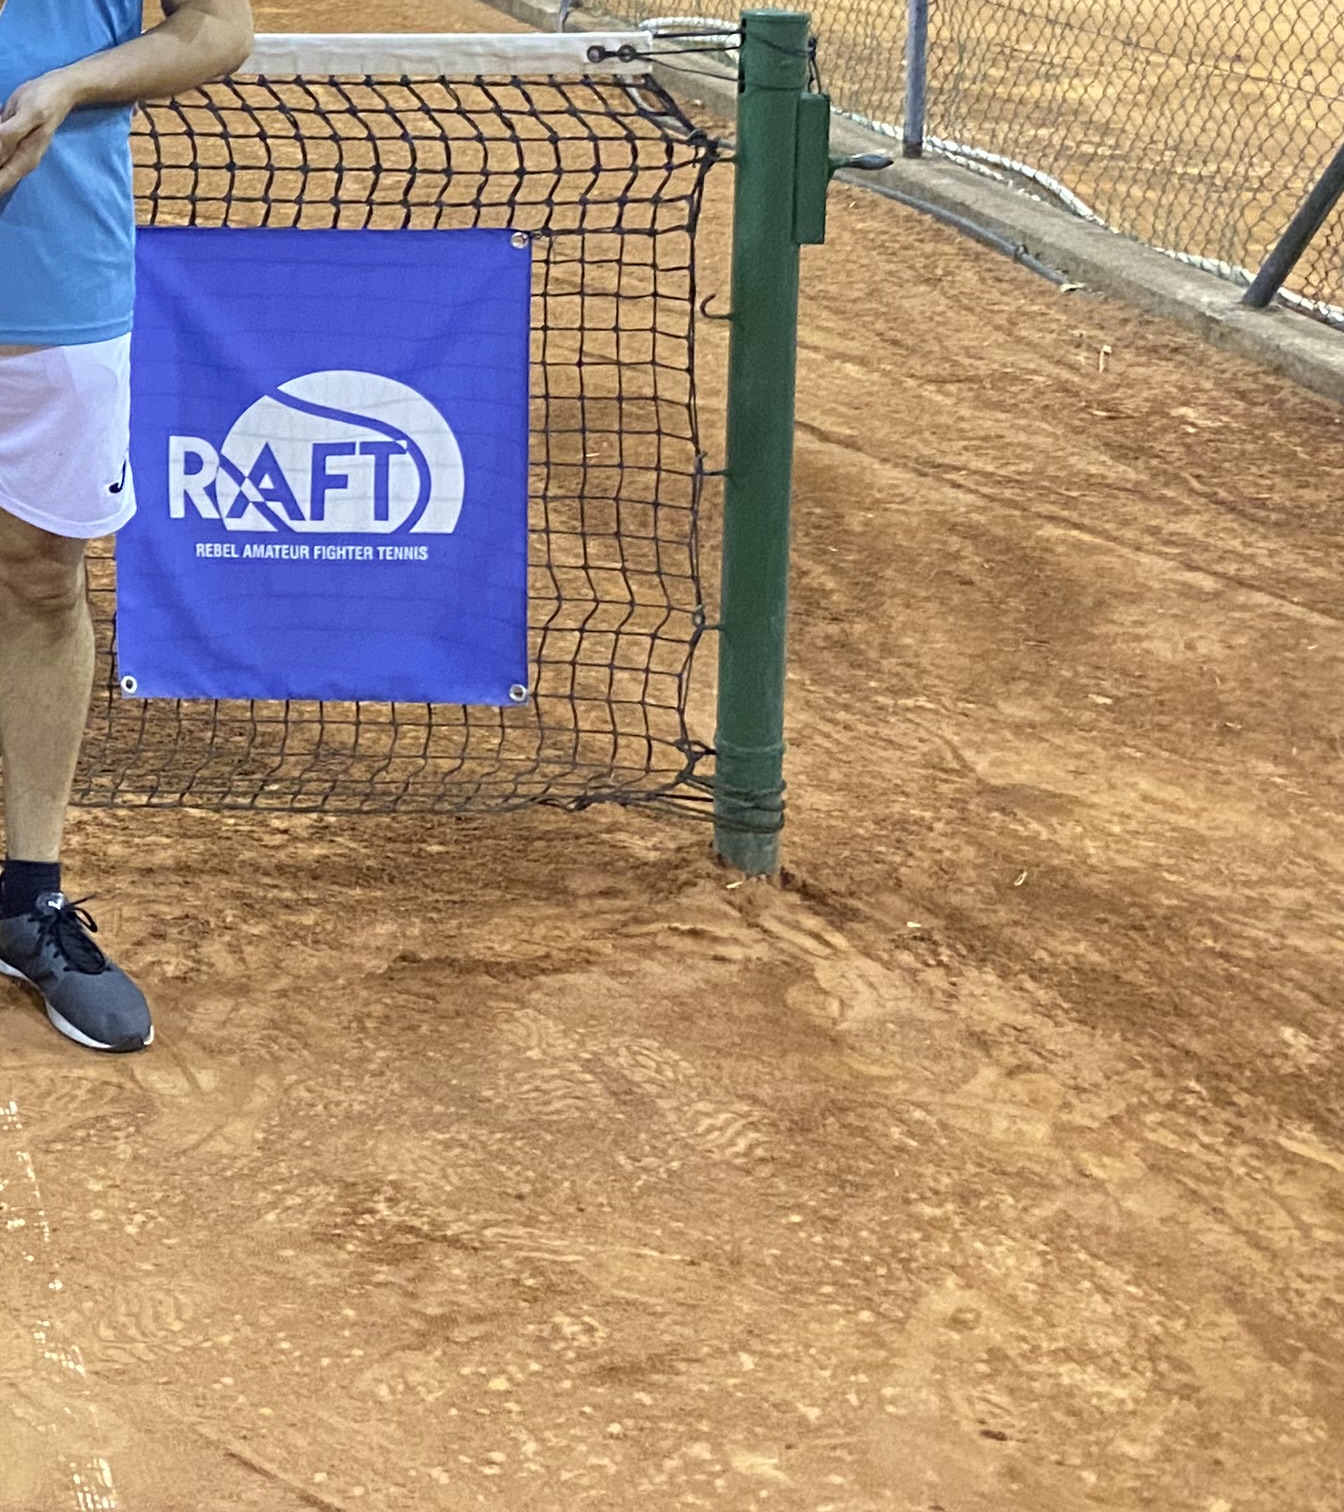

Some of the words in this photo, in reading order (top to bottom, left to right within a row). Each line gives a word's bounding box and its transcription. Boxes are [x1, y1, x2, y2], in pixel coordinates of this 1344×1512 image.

[169, 435, 408, 522] RAFT
[195, 542, 239, 558] REBEL
[243, 543, 310, 560] AMATEUR
[314, 544, 374, 561] FIGHTER
[377, 545, 429, 561] TENNIS
